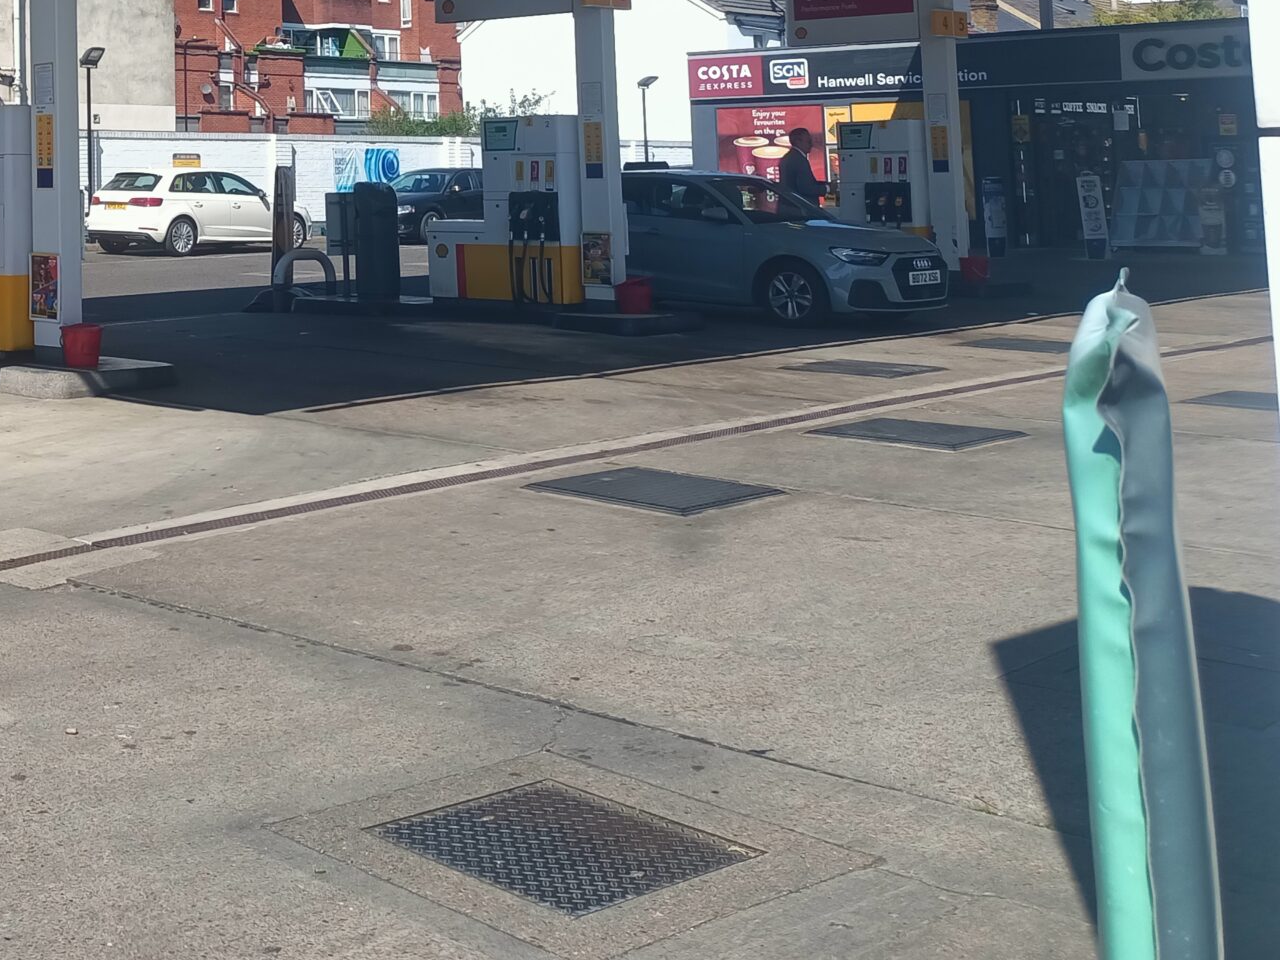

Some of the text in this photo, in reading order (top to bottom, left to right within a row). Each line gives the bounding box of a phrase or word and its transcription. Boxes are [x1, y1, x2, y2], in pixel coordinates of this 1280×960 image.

[942, 16, 948, 30] 4
[958, 18, 965, 31] 5
[1132, 35, 1251, 72] Cost
[697, 63, 752, 81] COSTA
[773, 63, 805, 78] SGN
[701, 81, 753, 91] EXPRESS
[817, 74, 873, 88] Hanwell
[876, 73, 923, 87] Servic
[752, 110, 786, 120] Enjoy your
